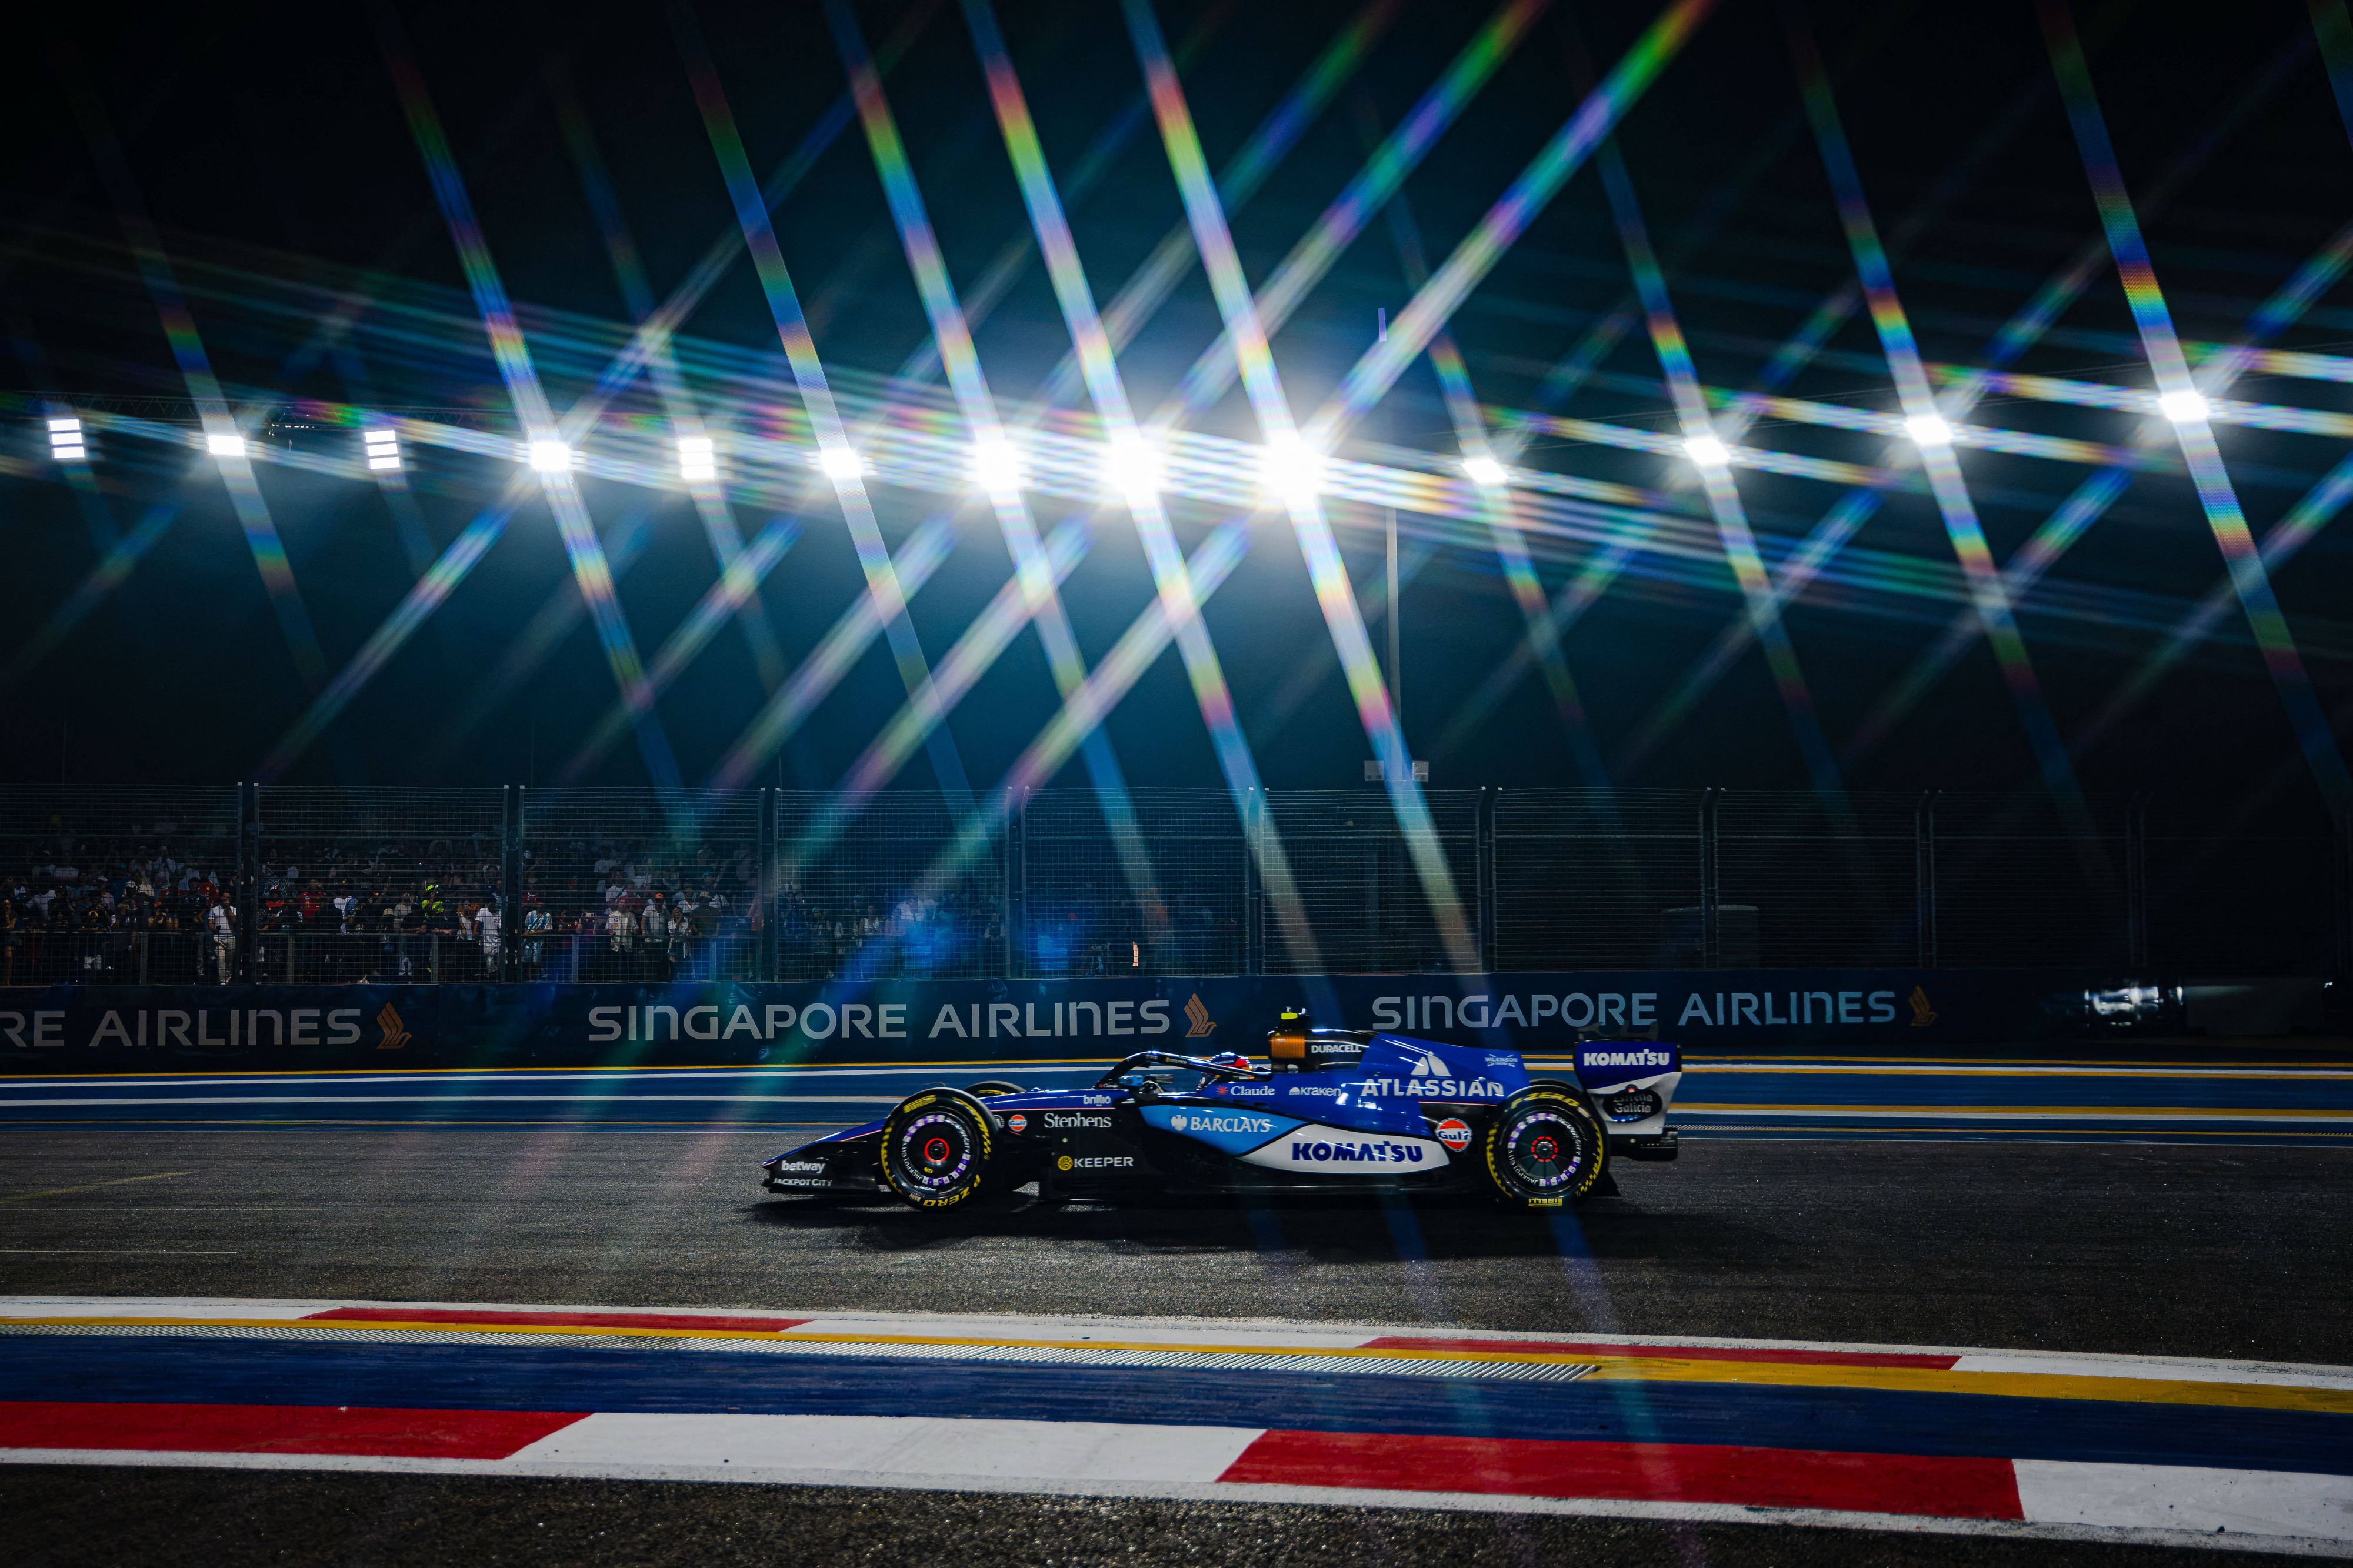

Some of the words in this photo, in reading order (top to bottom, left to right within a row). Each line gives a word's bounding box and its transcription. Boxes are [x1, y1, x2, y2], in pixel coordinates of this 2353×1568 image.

[1372, 992, 1657, 1029] SINGAPORE
[1677, 990, 1895, 1026] AIRLINES
[89, 1009, 360, 1047] AIRLINES
[588, 1003, 907, 1041] SINGAPORE
[928, 1000, 1171, 1039] AIRLINES
[1311, 1045, 1361, 1053] DURACELL
[1583, 1049, 1671, 1066] KOMATSU
[1230, 1086, 1275, 1096] Claude
[1361, 1079, 1505, 1097] ATLASSIAN
[1191, 1117, 1271, 1133] BARCLAYS
[1438, 1130, 1469, 1140] Gulf
[1292, 1141, 1423, 1162] KOMATSU
[781, 1160, 826, 1174] betway
[1074, 1157, 1134, 1168] KEEPER
[922, 1186, 971, 1207] ZERO
